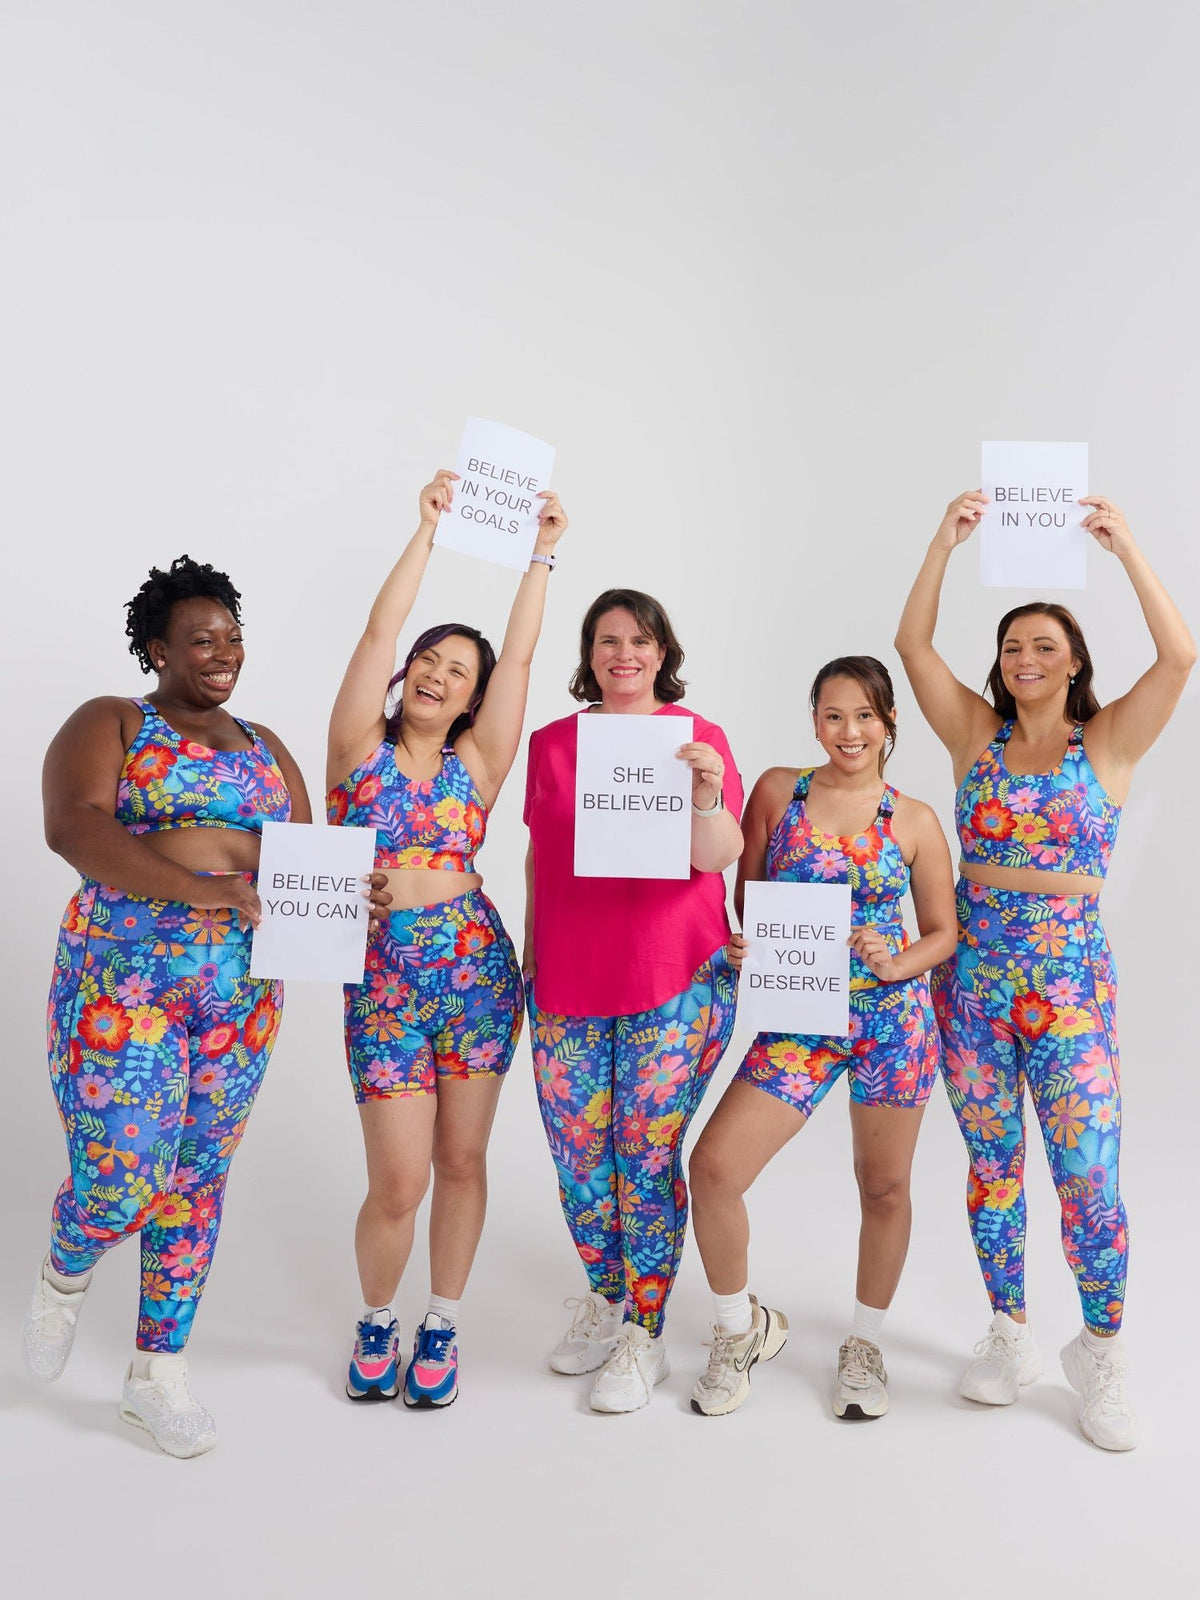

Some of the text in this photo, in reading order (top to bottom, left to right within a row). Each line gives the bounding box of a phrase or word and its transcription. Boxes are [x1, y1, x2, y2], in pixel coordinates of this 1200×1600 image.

[467, 458, 538, 492] BELIEVE
[461, 480, 532, 515] IN YOUR
[995, 487, 1073, 503] BELIEVE
[461, 505, 519, 534] GOALS
[1001, 511, 1066, 528] IN YOU
[612, 766, 655, 784] SHE
[583, 793, 684, 812] BELIEVED
[272, 872, 357, 894] BELIEVE
[266, 899, 359, 920] YOU CAN
[756, 922, 836, 941] BELIEVE
[774, 948, 816, 966] YOU
[749, 973, 841, 993] DESERVE
